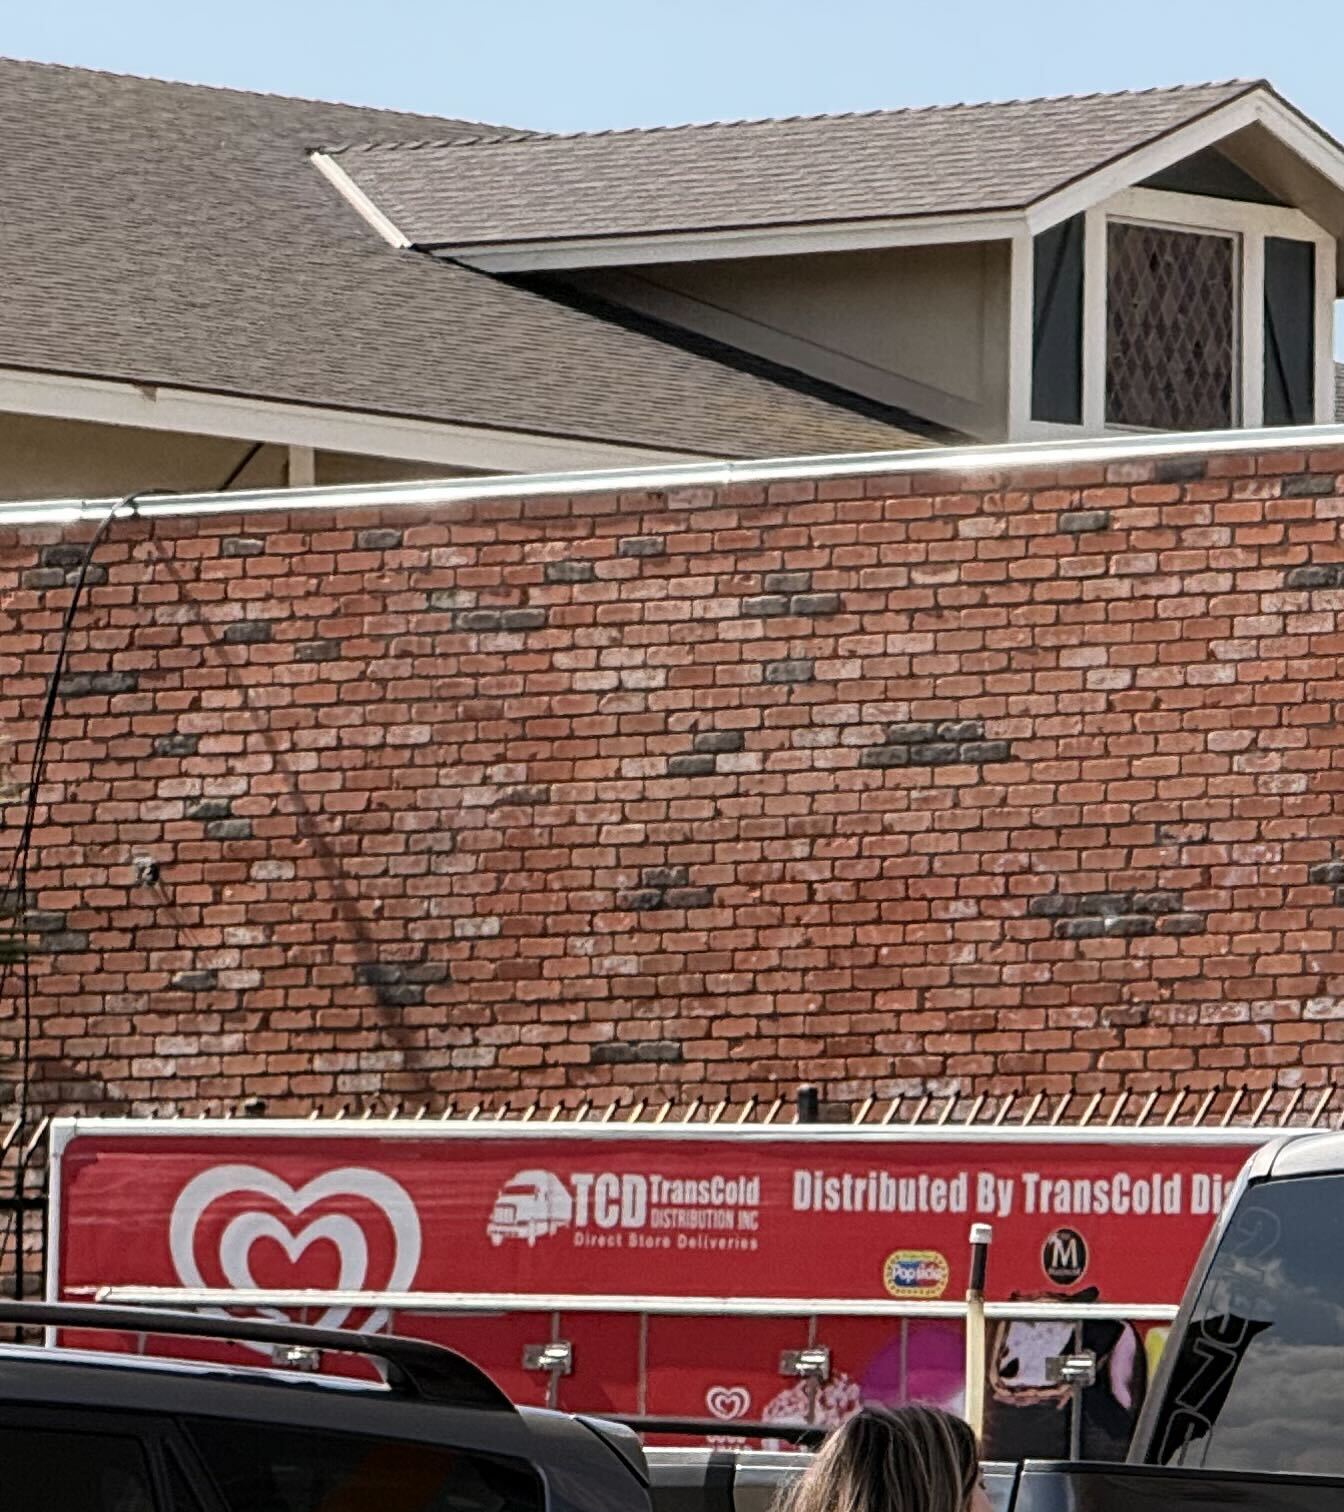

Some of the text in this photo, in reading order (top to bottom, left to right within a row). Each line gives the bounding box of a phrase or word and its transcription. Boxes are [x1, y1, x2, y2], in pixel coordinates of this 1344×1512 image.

[571, 1172, 760, 1229] TCD TransCold
[793, 1169, 968, 1213] Distributed
[977, 1172, 1014, 1218] By
[1021, 1173, 1182, 1215] TransCold
[650, 1208, 759, 1231] DISTRIBUTION INC
[573, 1232, 758, 1250] Direct Store Deliveries
[1051, 1236, 1079, 1268] M
